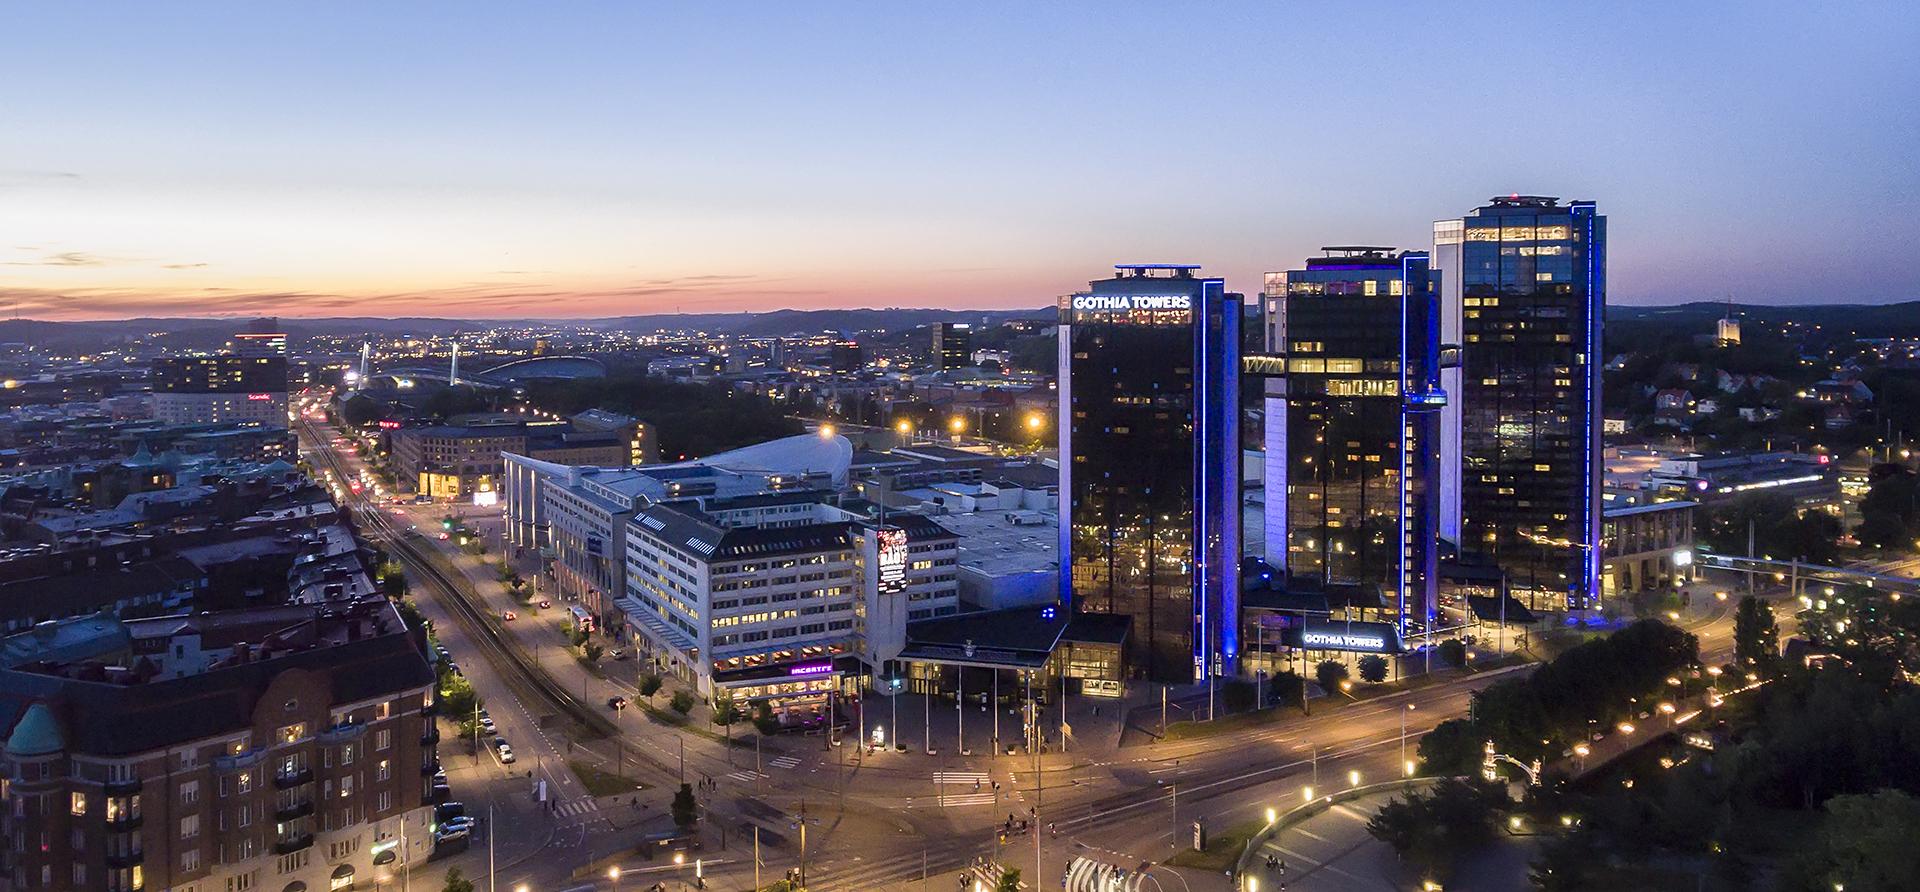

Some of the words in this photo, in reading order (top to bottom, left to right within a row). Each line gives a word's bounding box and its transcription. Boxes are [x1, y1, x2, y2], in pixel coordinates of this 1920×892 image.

[1073, 296, 1130, 309] GOTHIA
[1132, 296, 1191, 309] TOWERS
[1304, 634, 1343, 645] GOTHIA
[1343, 637, 1384, 648] TOWERS
